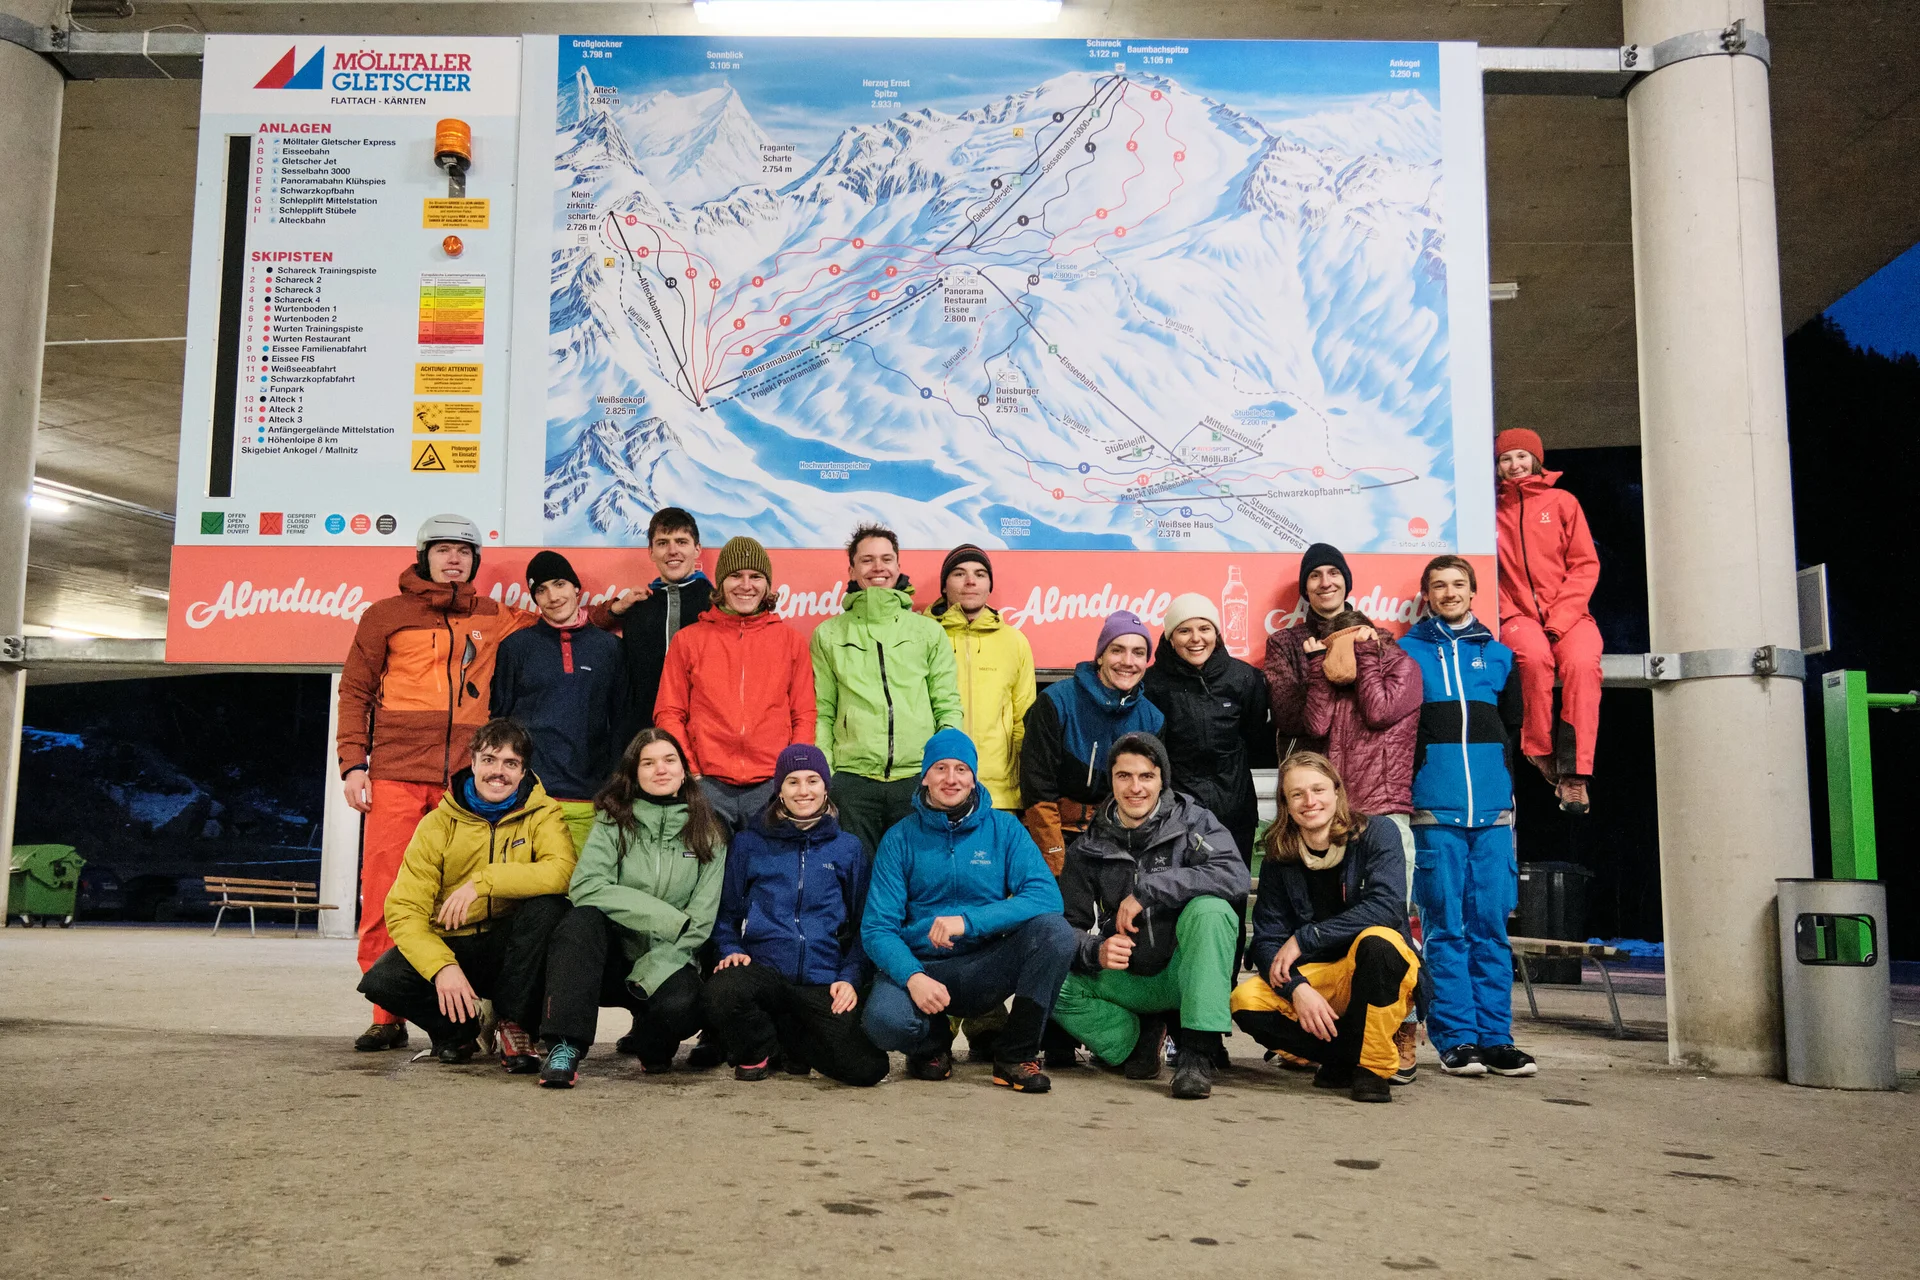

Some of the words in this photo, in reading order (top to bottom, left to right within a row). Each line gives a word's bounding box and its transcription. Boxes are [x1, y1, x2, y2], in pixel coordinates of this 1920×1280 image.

[573, 40, 622, 49] Großglockner
[707, 51, 744, 59] Sonnblick
[1128, 46, 1188, 56] Baumbachspitze
[333, 50, 472, 72] MÖLLTALER
[1390, 60, 1420, 69] Ankogel
[332, 73, 471, 92] GLETSCHER
[863, 80, 887, 88] Herzog
[875, 90, 897, 99] Spitze
[331, 97, 375, 105] FLATTACH
[384, 96, 426, 105] KÄRNTEN
[259, 123, 332, 133] ANLAGEN
[760, 144, 795, 152] Fraganter
[281, 187, 354, 195] Schwarzkopfbahn
[280, 207, 322, 215] Schlepplift
[252, 252, 333, 262] SKIPISTEN
[639, 277, 663, 321] Alteckbahn
[628, 306, 651, 330] Variante
[1165, 317, 1194, 333] Variante
[942, 345, 968, 369] Variante
[742, 349, 802, 378] Panoramabahn
[271, 376, 355, 384] Schwarzkopfabfahrt
[751, 382, 777, 399] Projekt
[777, 357, 829, 386] Panoramabahn
[1061, 357, 1098, 393] Eisseebahn
[270, 386, 304, 394] Funpark
[996, 387, 1039, 396] Duisburger
[597, 395, 645, 405] Weißseekopf
[1063, 414, 1090, 434] Variante
[268, 426, 339, 435] Anfängergelände
[1204, 415, 1264, 451] Mittelstationlift
[268, 437, 315, 445] Höhenloipe
[1105, 435, 1147, 455] Stübelelift
[242, 447, 280, 455] Skigebiet
[283, 447, 317, 455] Ankogel
[1267, 487, 1344, 499] Schwarzkopfbahn
[1250, 497, 1304, 535] Standseilbahn
[1236, 504, 1272, 532] Gletscher
[1272, 527, 1304, 550] Express
[186, 577, 373, 629] Almdudle
[999, 583, 1171, 630] Almdudl
